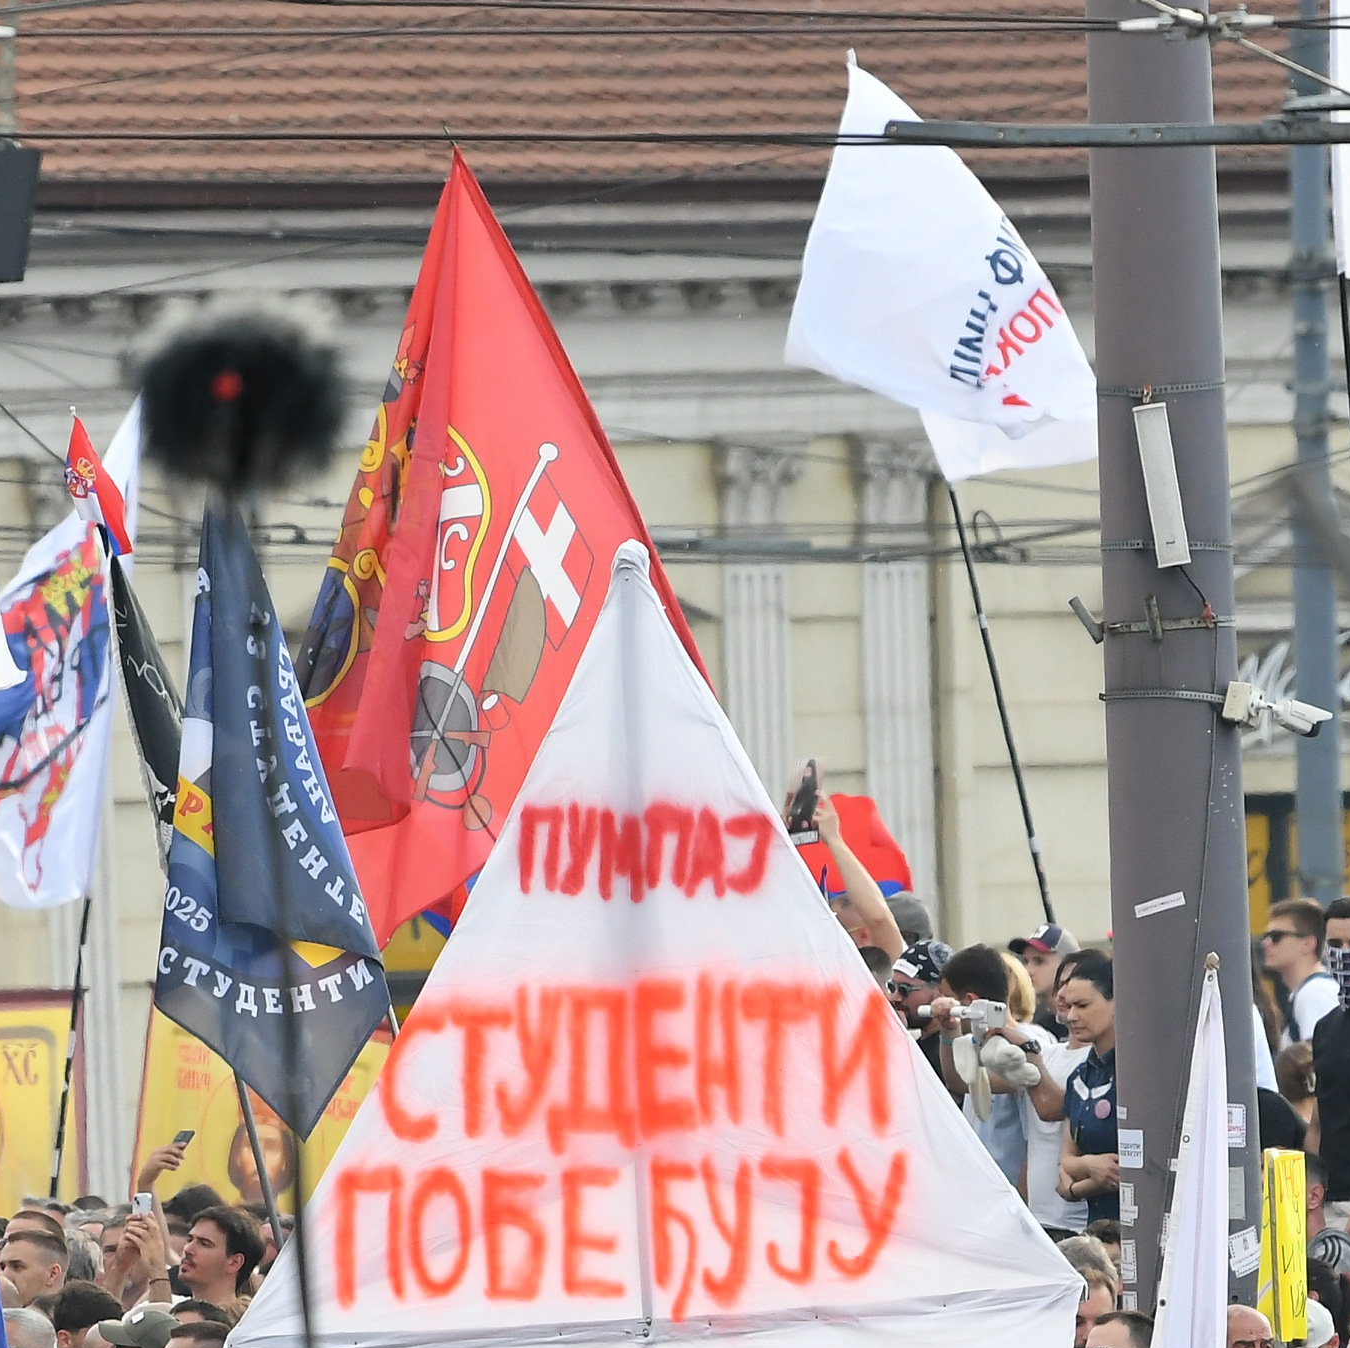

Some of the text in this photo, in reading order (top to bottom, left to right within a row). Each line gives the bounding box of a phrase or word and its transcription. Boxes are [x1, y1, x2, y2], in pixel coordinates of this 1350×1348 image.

[517, 797, 779, 903] ПУМПАЈ
[157, 946, 375, 1018] СТУДЕНТИ
[379, 971, 896, 1154] СТУДЕНТИ
[332, 1150, 909, 1323] ПОБЕЂУЈУ
